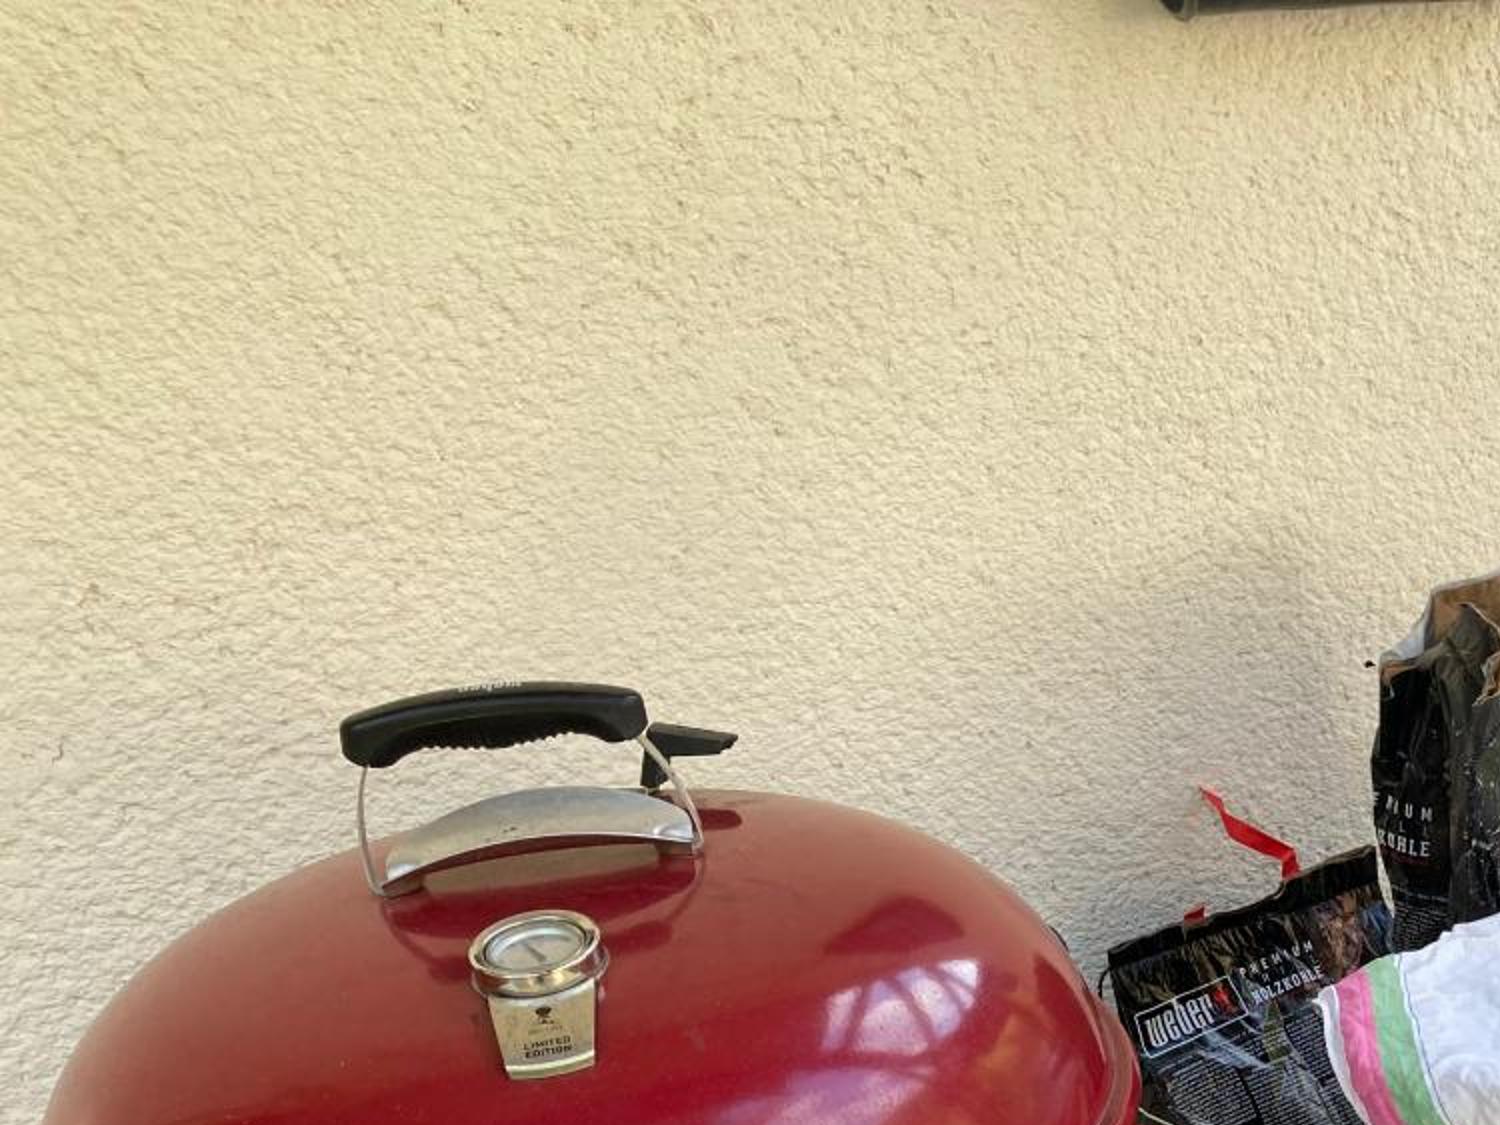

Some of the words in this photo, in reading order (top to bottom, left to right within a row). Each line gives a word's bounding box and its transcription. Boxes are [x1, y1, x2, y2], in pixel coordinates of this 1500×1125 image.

[1143, 993, 1215, 1048] weber
[523, 1035, 571, 1050] LIMITED
[525, 1044, 573, 1059] EDITION
